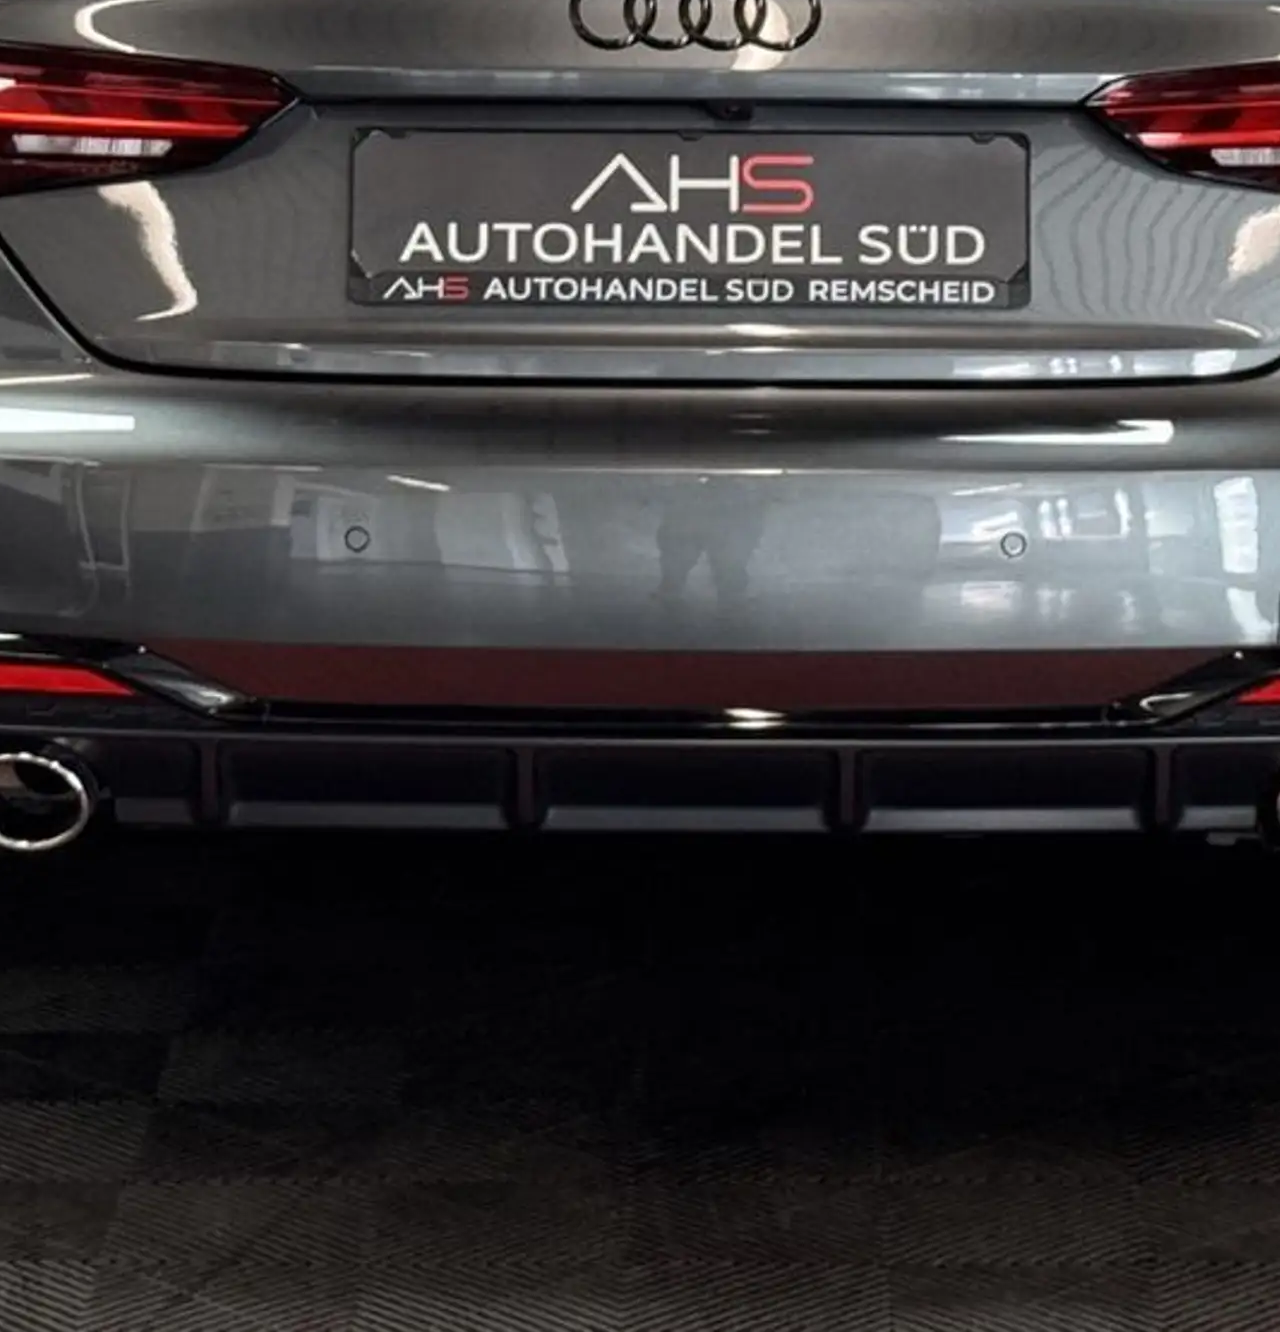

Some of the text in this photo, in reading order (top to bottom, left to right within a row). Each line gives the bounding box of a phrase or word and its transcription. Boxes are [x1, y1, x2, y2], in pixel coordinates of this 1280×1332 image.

[570, 153, 815, 214] AHS
[399, 221, 986, 266] AUTOHANDEL SÜD
[383, 276, 996, 304] AHS AUTOHANDEL SÜD REMSCHEID
